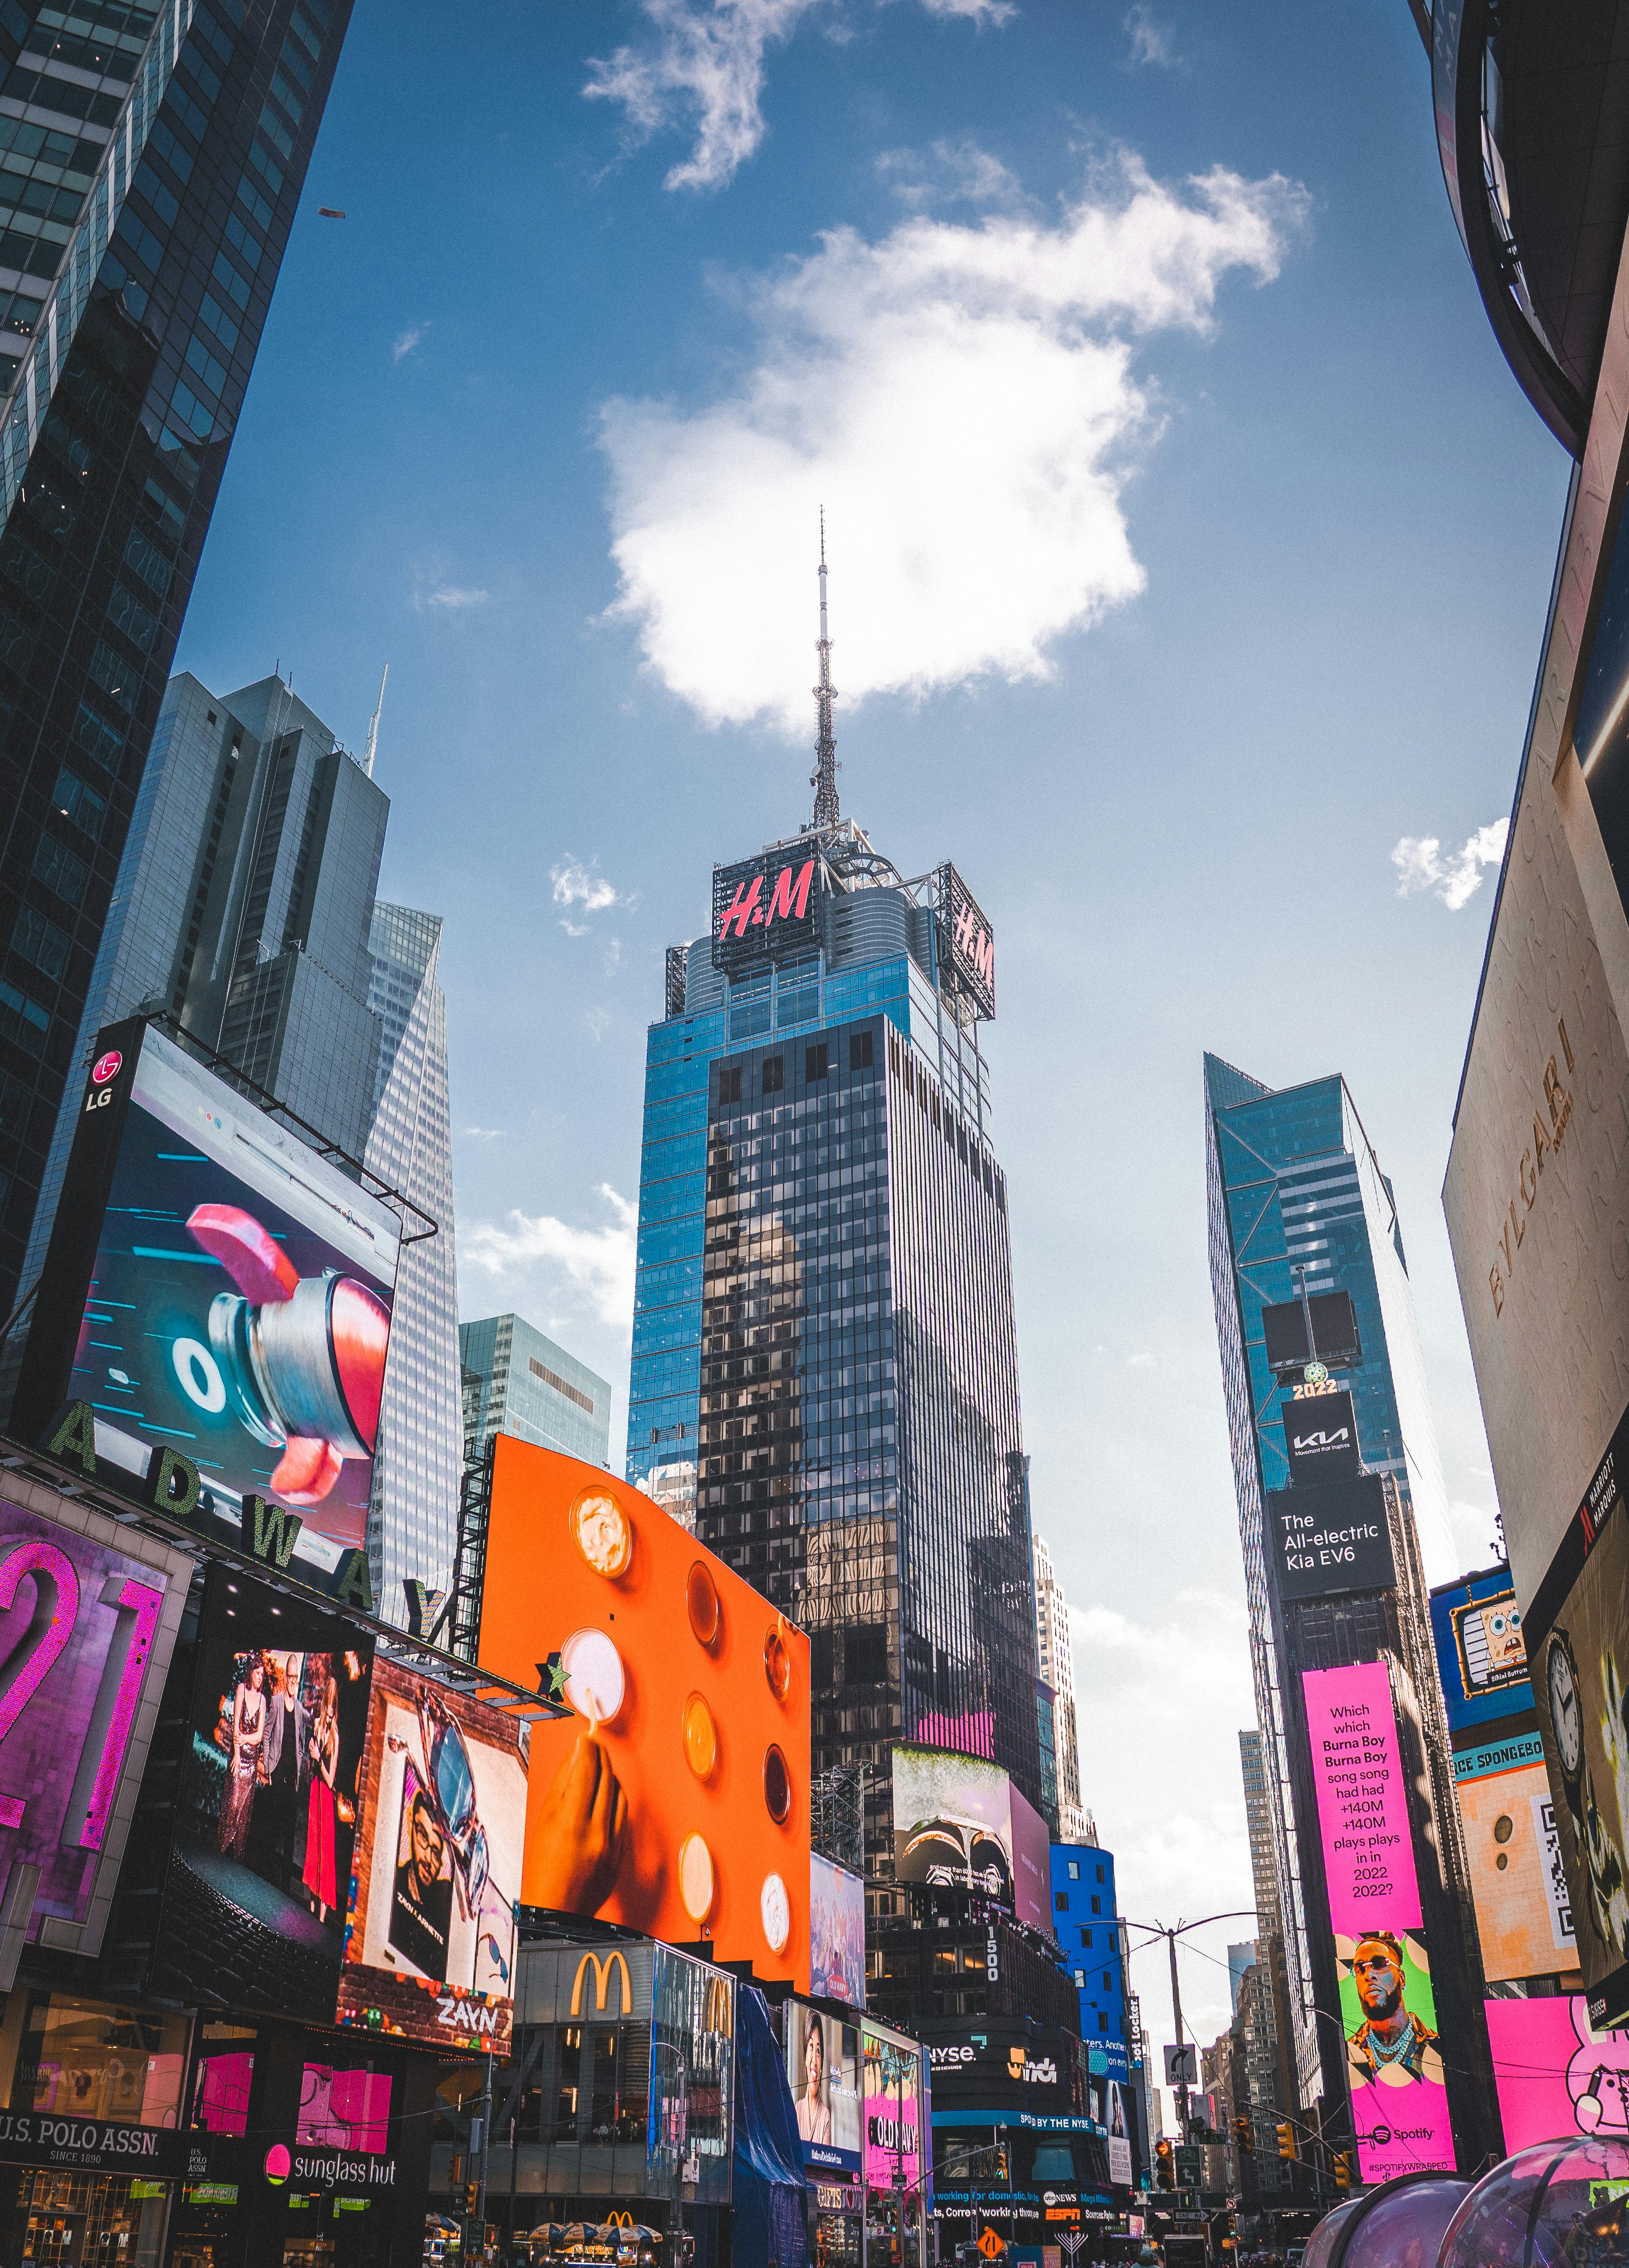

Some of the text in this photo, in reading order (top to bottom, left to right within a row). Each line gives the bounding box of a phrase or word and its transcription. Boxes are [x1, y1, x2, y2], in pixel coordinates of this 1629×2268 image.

[719, 860, 814, 941] H&M
[955, 903, 994, 990] H&M
[86, 1088, 112, 1111] LG
[1293, 1379, 1338, 1400] 2022
[1295, 1448, 1320, 1456] Movement
[1589, 1452, 1614, 1507] MARRIOTT
[1593, 1479, 1616, 1527] MARQUIS
[1281, 1515, 1314, 1531] The
[1284, 1523, 1379, 1551] All-electric
[1286, 1546, 1355, 1571] Kia EV6
[1491, 1667, 1528, 1682] Bikini Bottom
[1330, 1704, 1370, 1719] Which
[1334, 1720, 1370, 1733] which
[1323, 1735, 1385, 1752] Burna Boy
[1325, 1752, 1388, 1768] Burna Boy
[1477, 1740, 1543, 1769] SPONGEBO
[1328, 1768, 1389, 1784] song song
[1336, 1783, 1384, 1799] had had
[1341, 1800, 1384, 1814] +140M
[1343, 1816, 1386, 1831] +140M
[1334, 1833, 1400, 1852] plays plays
[1356, 1850, 1381, 1863] in in
[1354, 1867, 1388, 1881] 2022
[1352, 1883, 1393, 1898] 2022?
[988, 1926, 999, 1982] 1500
[837, 1982, 846, 1993] NAVY
[436, 1998, 498, 2033] ZAYN
[1171, 2073, 1192, 2081] ONLY
[877, 2115, 894, 2148] OLD
[1037, 2118, 1047, 2128] BY
[1050, 2118, 1069, 2128] THE
[1072, 2119, 1089, 2129] NYSE.
[38, 2120, 97, 2149] POLO
[100, 2128, 158, 2156] ASSN.
[1394, 2128, 1432, 2142] Spotify
[50, 2150, 101, 2164] SINCE 1890
[295, 2153, 396, 2187] sunglass hut
[1369, 2162, 1448, 2172] #SPOTIFYWRAPPED
[817, 2185, 842, 2209] GIFTS
[937, 2190, 969, 2202] working
[1056, 2194, 1077, 2202] NEWS
[1081, 2193, 1095, 2205] Mega
[1046, 2208, 1081, 2221] ESPN
[1085, 2209, 1104, 2220] Sources:
